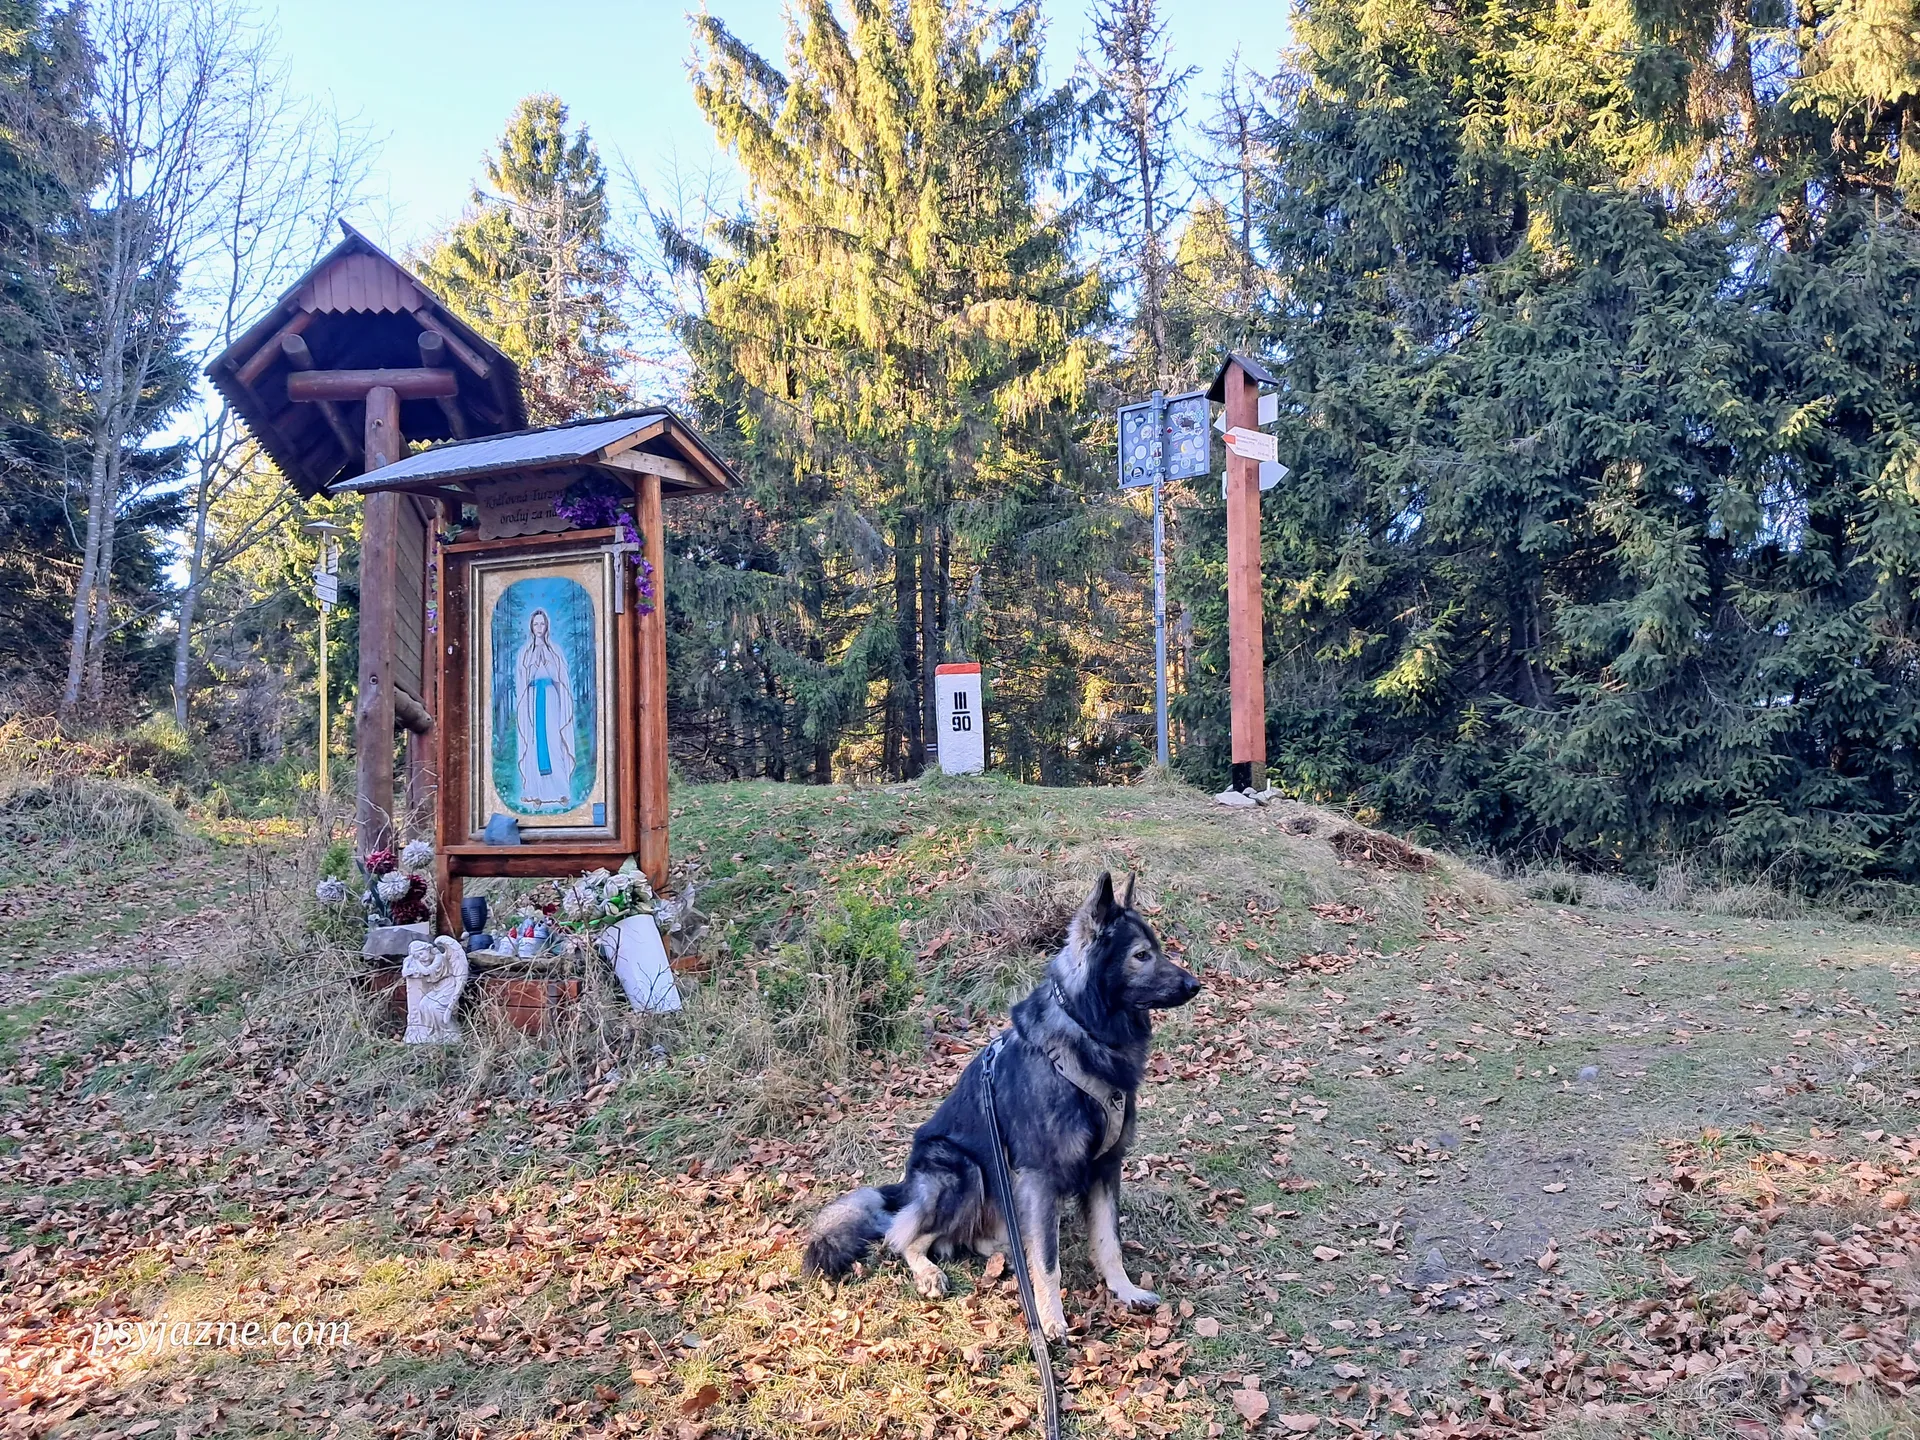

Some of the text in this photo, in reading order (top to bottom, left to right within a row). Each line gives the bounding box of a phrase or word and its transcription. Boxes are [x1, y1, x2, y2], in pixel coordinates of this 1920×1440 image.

[500, 508, 530, 525] oroduj
[531, 510, 543, 520] za
[954, 692, 967, 709] III
[952, 716, 971, 731] 90
